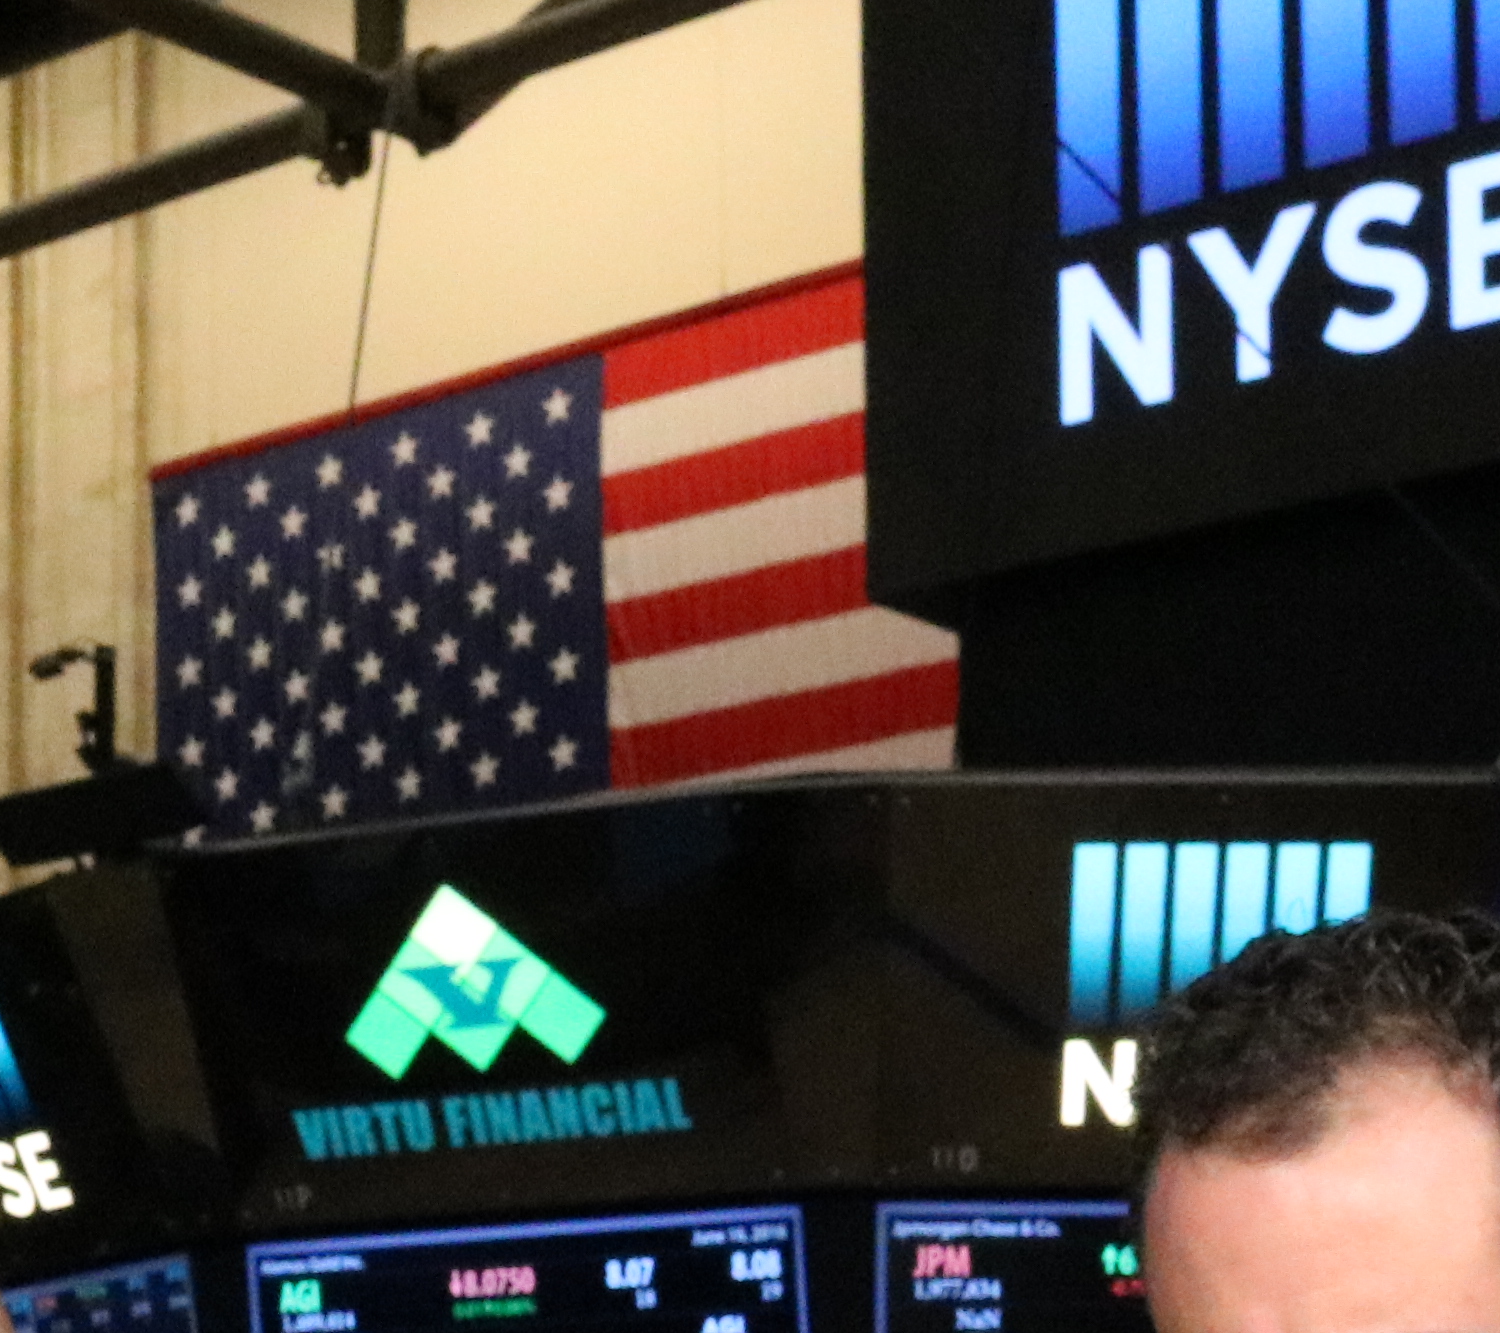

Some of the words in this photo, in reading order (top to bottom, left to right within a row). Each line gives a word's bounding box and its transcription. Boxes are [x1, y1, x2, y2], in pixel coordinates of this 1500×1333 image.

[291, 1101, 437, 1162] VIRTU
[443, 1076, 693, 1150] FINANCIAL
[911, 1243, 972, 1278] JPM
